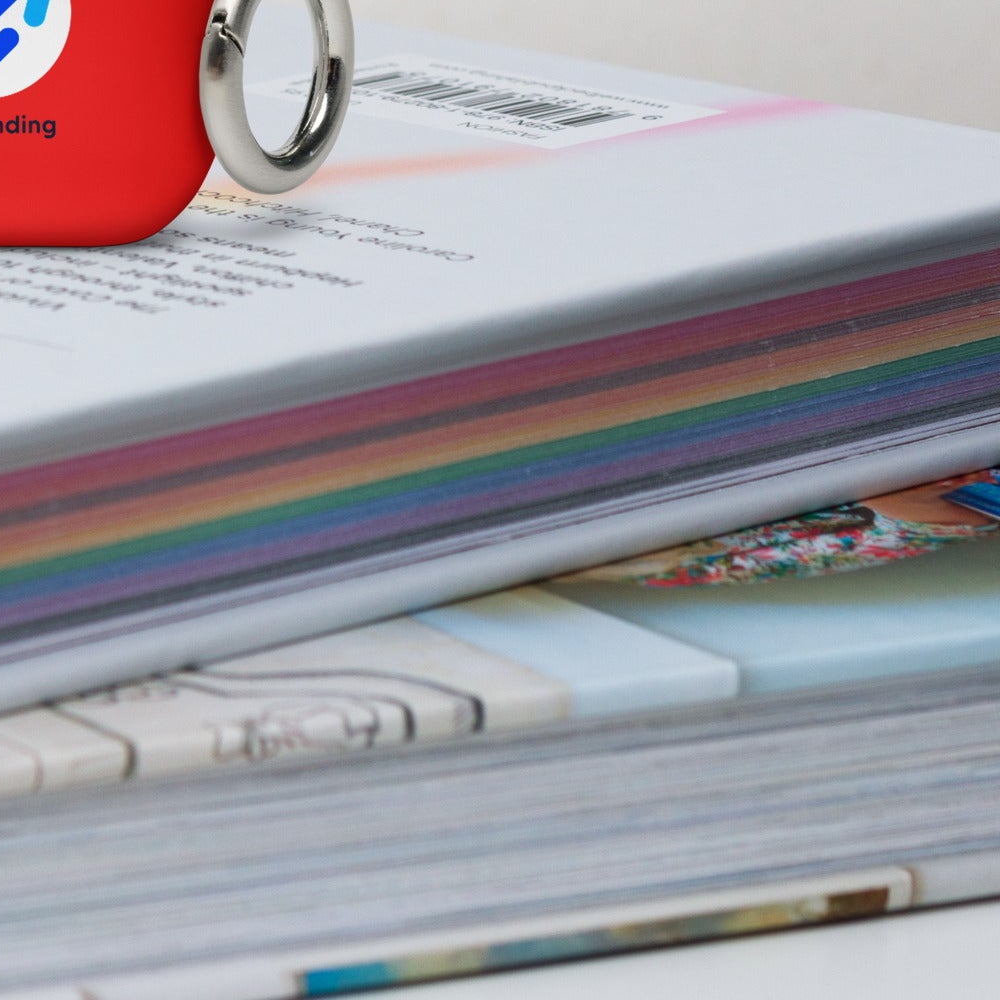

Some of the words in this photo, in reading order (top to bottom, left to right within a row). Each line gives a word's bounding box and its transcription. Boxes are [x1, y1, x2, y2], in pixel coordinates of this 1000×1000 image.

[188, 204, 236, 218] the
[197, 189, 323, 217] Hitchcoc
[237, 213, 266, 224] is
[264, 218, 351, 241] Young
[197, 236, 297, 258] means
[357, 237, 475, 263] Caroline
